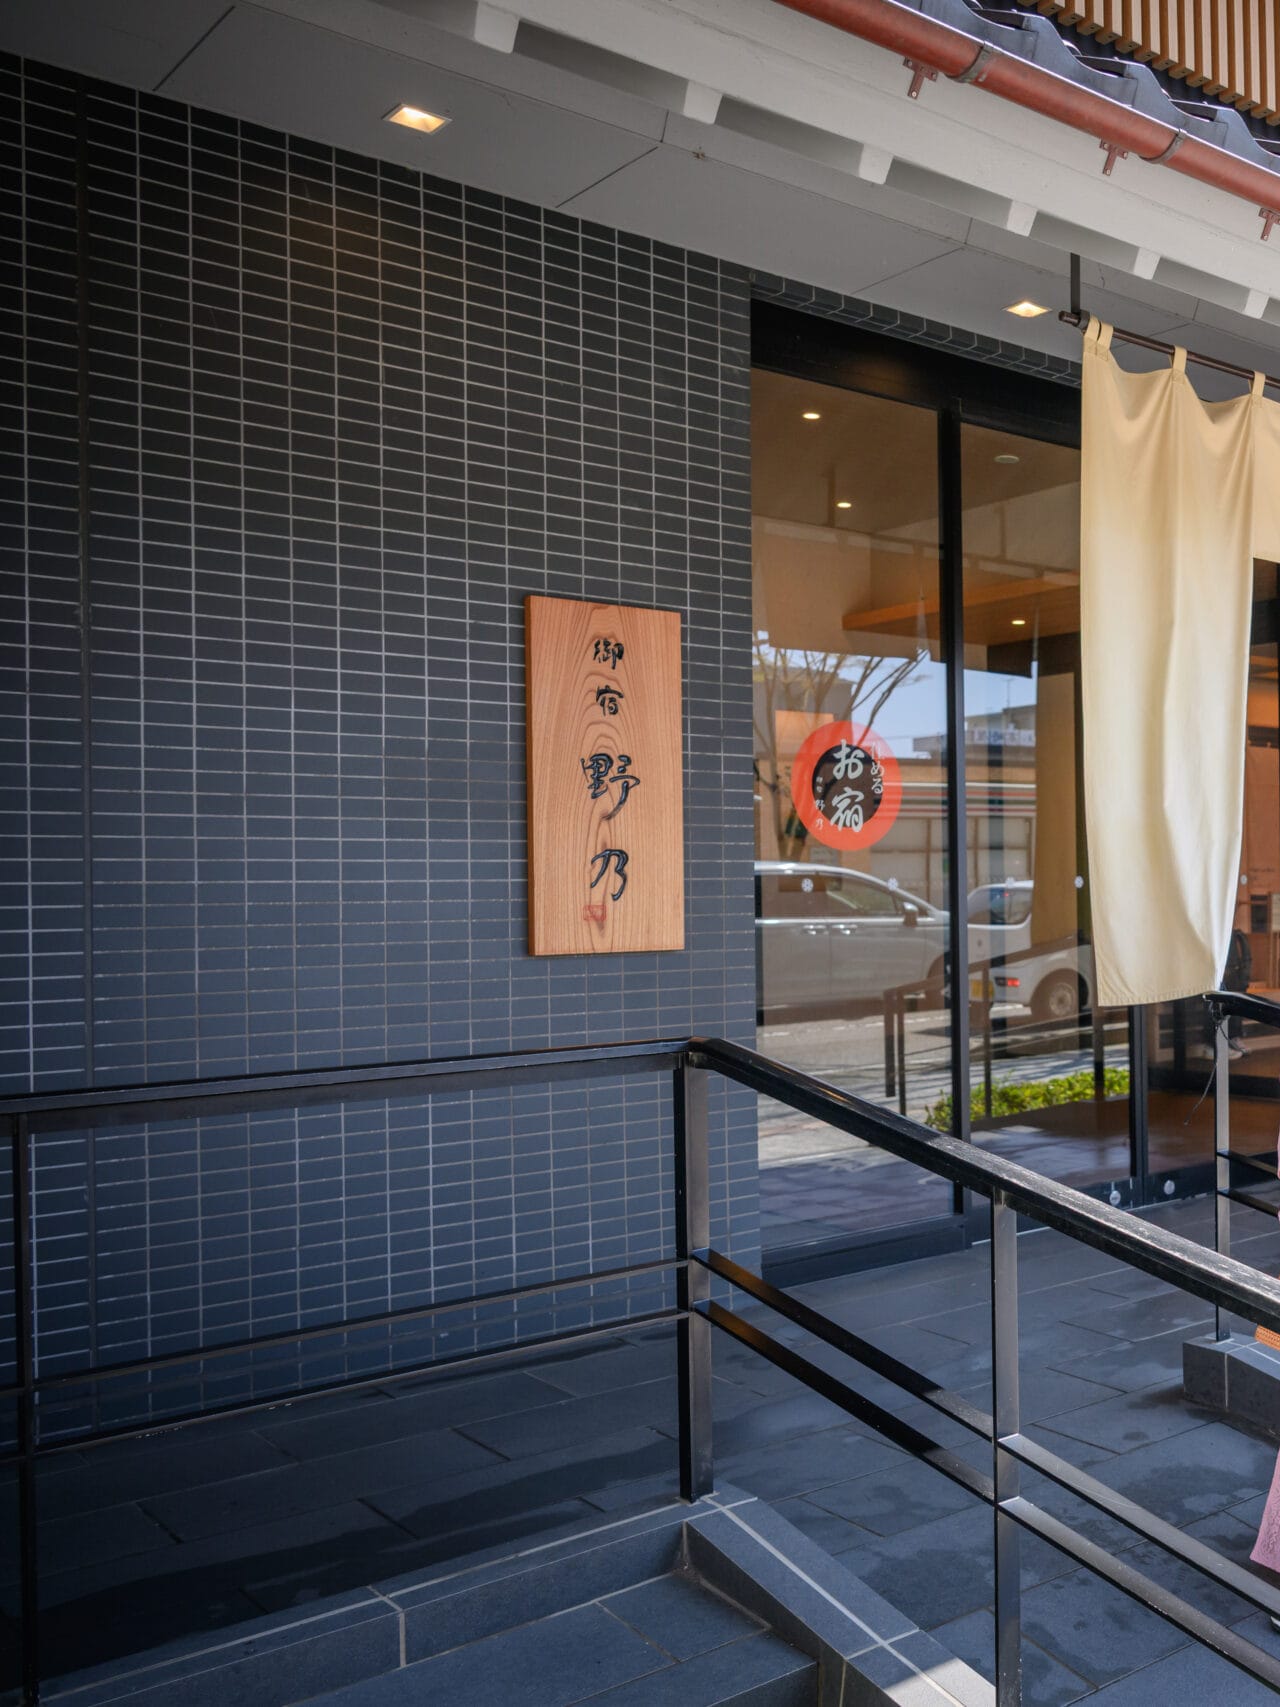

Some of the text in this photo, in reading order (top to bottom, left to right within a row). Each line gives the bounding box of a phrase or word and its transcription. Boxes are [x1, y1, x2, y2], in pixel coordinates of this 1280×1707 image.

[581, 640, 640, 901] 御宿野乃
[830, 739, 865, 832] お宿
